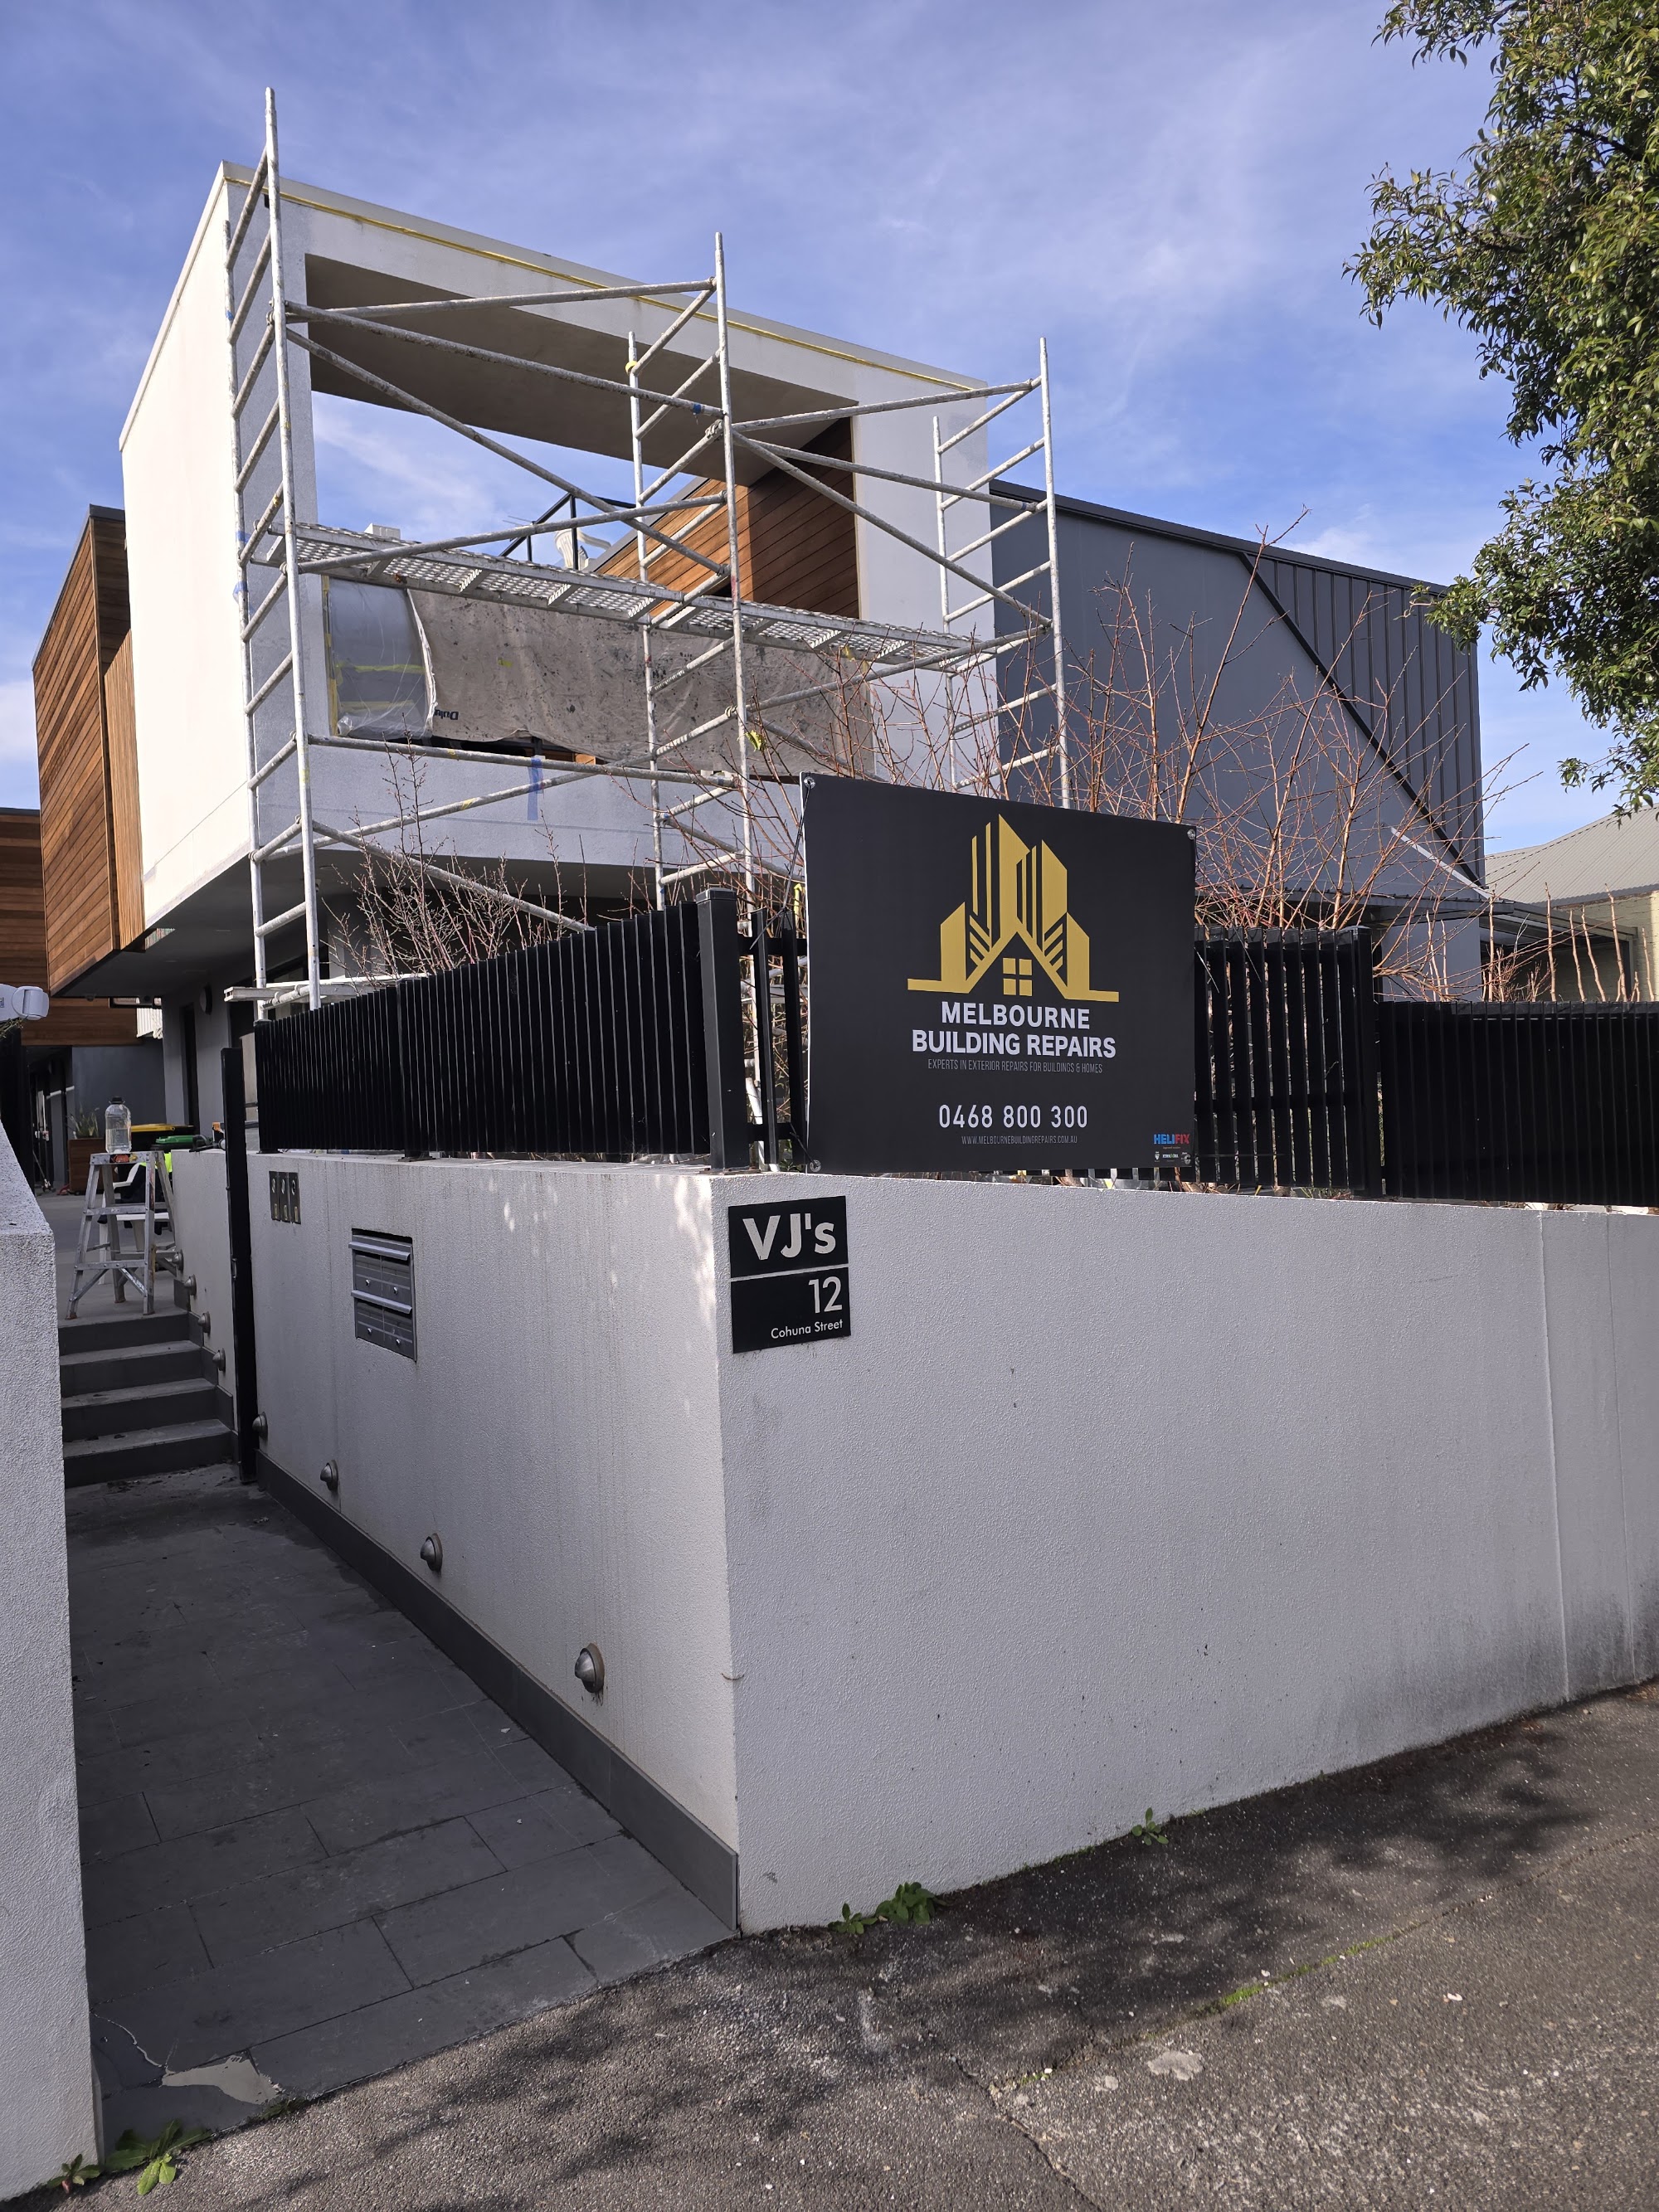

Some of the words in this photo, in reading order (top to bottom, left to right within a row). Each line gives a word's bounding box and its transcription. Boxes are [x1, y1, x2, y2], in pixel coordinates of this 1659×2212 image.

[433, 709, 459, 721] Dulu
[941, 1001, 1090, 1029] MELBOURNE
[912, 1029, 1020, 1056] BUILDING
[1027, 1035, 1117, 1058] REPAIRS
[927, 1059, 958, 1070] EXPERTS
[960, 1060, 967, 1070] IN
[968, 1060, 1000, 1071] EXTERIOR
[1001, 1061, 1029, 1072] REPAIRS
[1029, 1062, 1042, 1072] FOR
[1043, 1062, 1075, 1072] BUILDINGS
[1076, 1062, 1081, 1072] &
[1082, 1063, 1103, 1073] HOMES
[939, 1104, 993, 1128] 0468
[1003, 1106, 1041, 1128] 800
[1050, 1106, 1087, 1128] 300
[961, 1135, 1078, 1145] WWW.MELBOURNEBUILDINGREPAIRS.COM.AU
[1154, 1134, 1190, 1145] HELIFIX
[742, 1213, 836, 1261] VJ's
[808, 1276, 843, 1314] 12
[771, 1326, 811, 1339] Cohuna
[814, 1319, 843, 1332] Street
